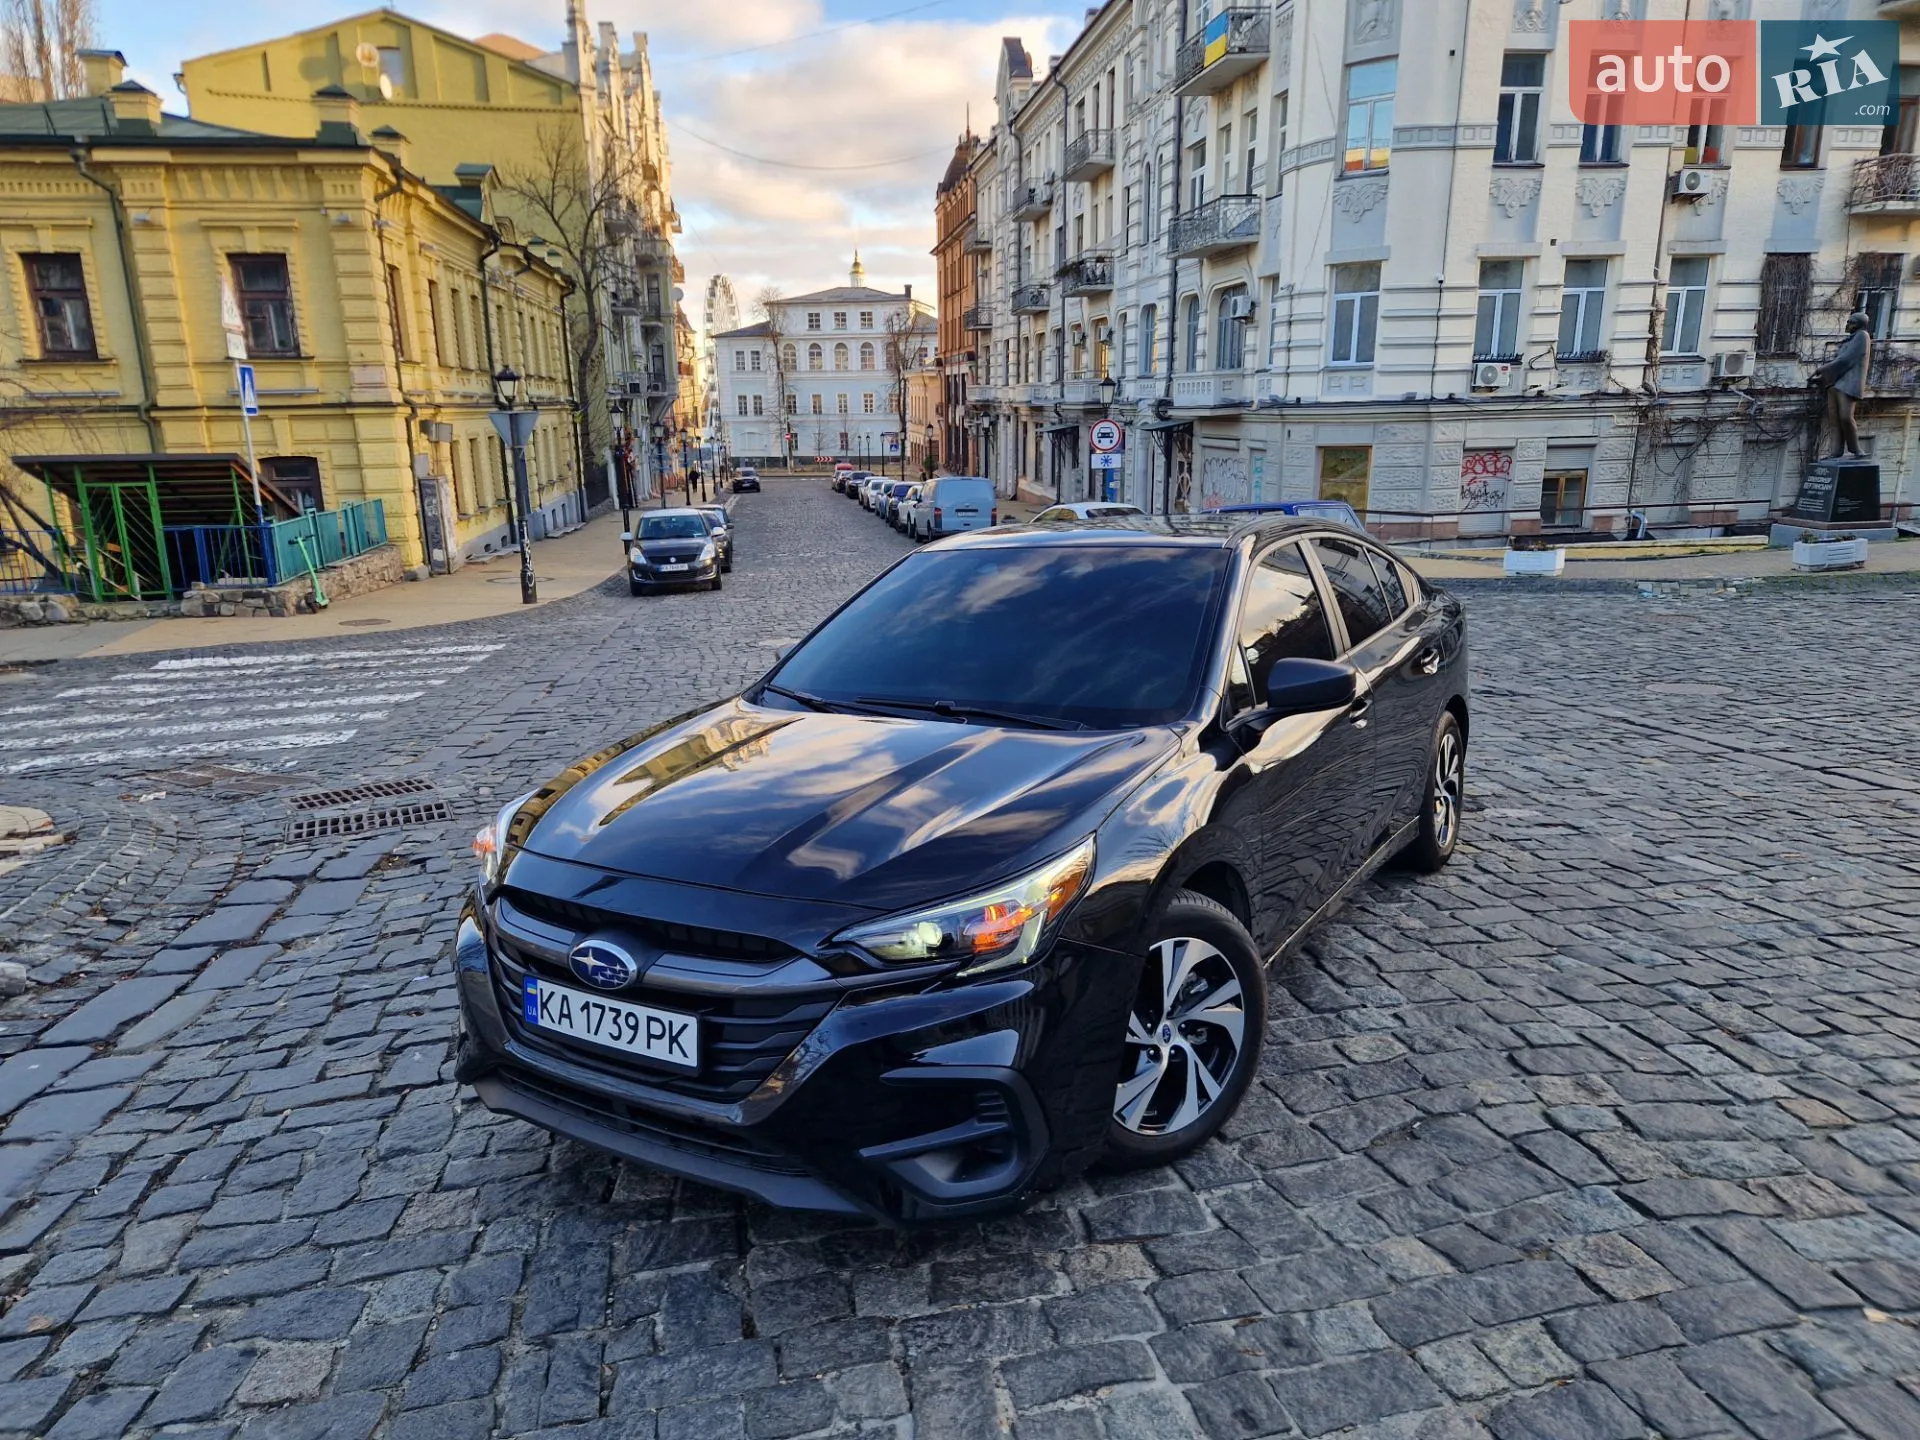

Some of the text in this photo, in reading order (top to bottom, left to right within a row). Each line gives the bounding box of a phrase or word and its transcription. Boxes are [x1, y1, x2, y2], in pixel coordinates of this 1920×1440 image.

[527, 1005, 537, 1017] UA
[539, 987, 689, 1059] KA 1739 PK
